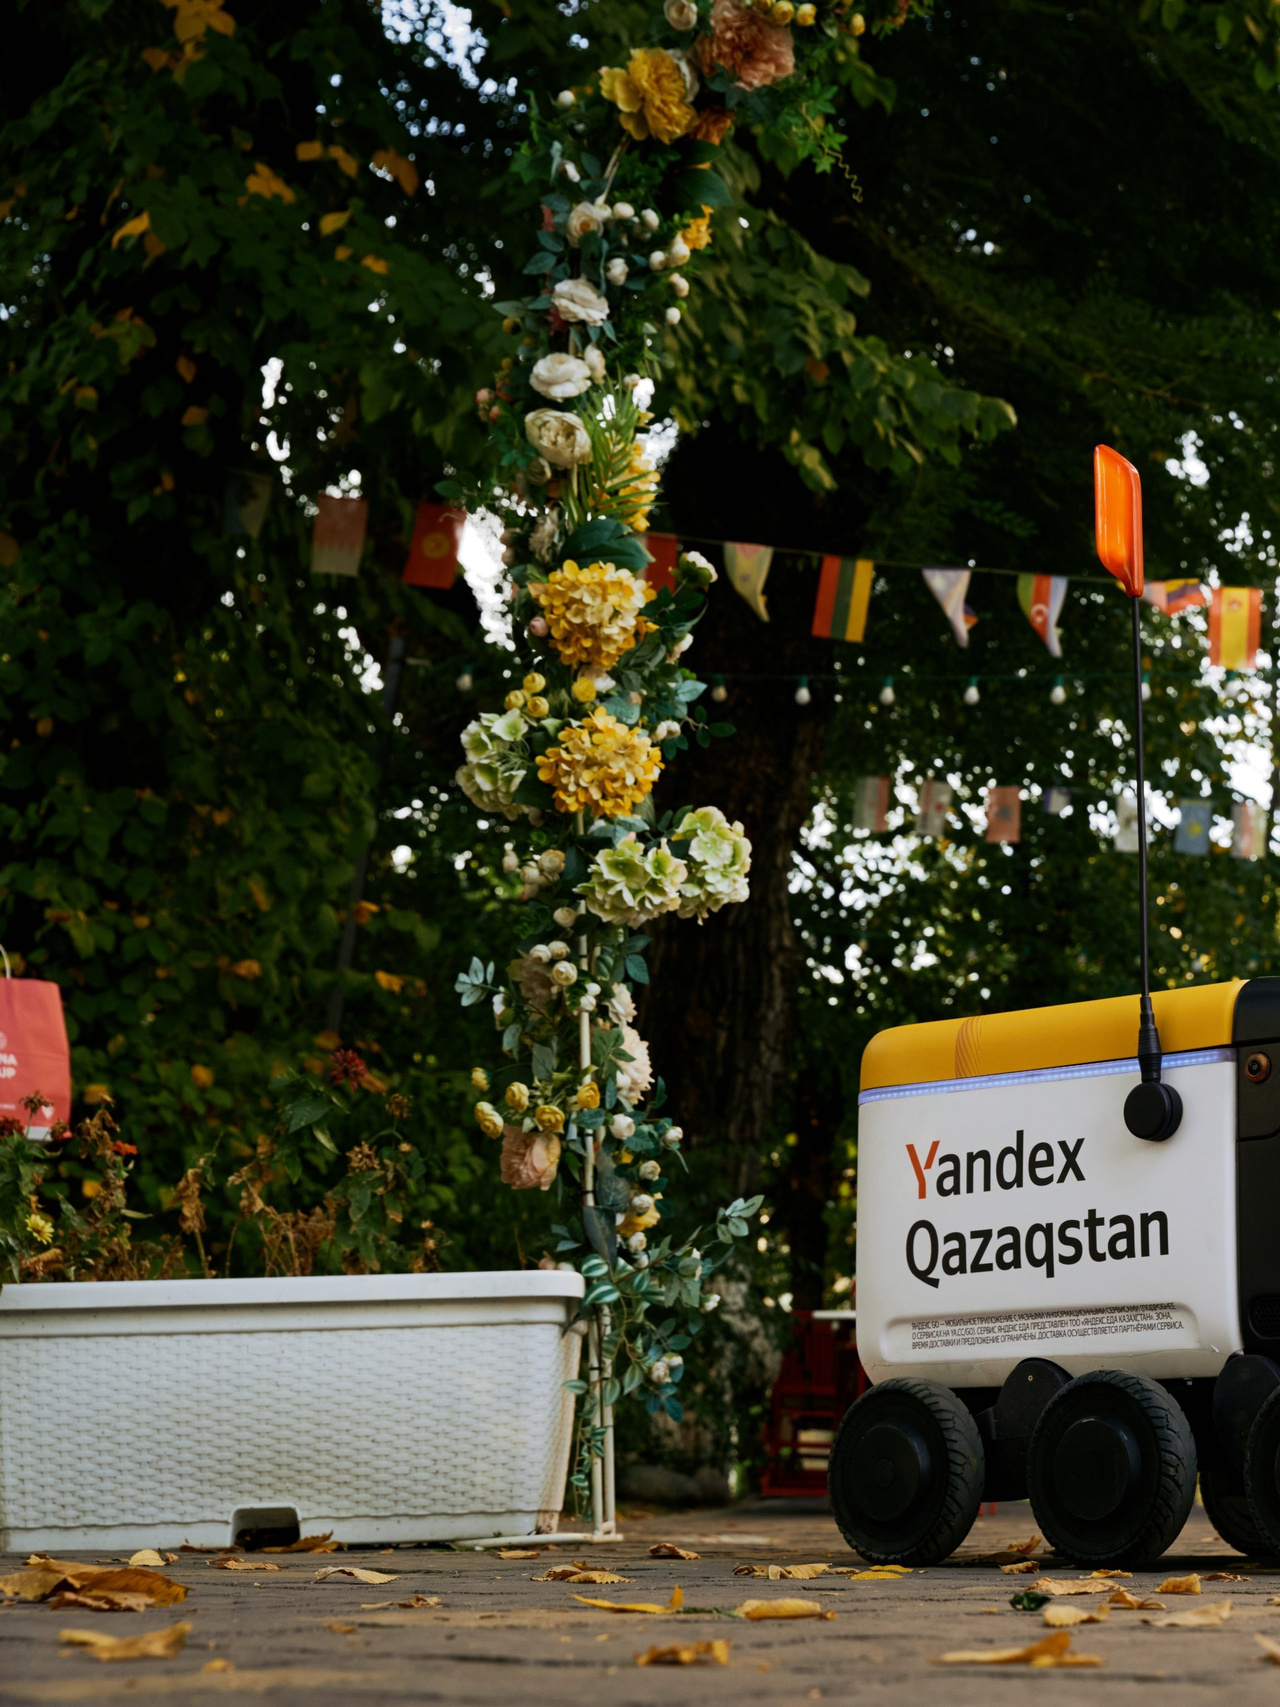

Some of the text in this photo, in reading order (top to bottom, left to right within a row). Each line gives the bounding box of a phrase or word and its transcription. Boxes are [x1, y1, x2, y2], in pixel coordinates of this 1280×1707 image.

[906, 1130, 1086, 1200] Yandex
[906, 1208, 1170, 1289] Qazaqstan
[917, 1329, 943, 1340] СЕРВИСАХ
[977, 1325, 997, 1335] СЕРВИС
[998, 1323, 1018, 1333] ЯНДЕКС
[1019, 1322, 1030, 1332] ЕДА
[1031, 1319, 1069, 1330] ПРЕДСТАВЛЕН
[1069, 1318, 1080, 1327] ТОО
[945, 1317, 977, 1328] МОБИЛЬНОЕ
[977, 1314, 1014, 1325] ПРИЛОЖЕНИЕ
[912, 1340, 929, 1349] ВРЕМЯ
[929, 1338, 956, 1349] ДОСТАВКИ
[961, 1335, 1000, 1346] ПРЕДЛОЖЕНИЕ
[1037, 1329, 1067, 1340] ДОСТАВКА
[1067, 1325, 1118, 1338] ОСУЩЕСТВЛЯЕТСЯ
